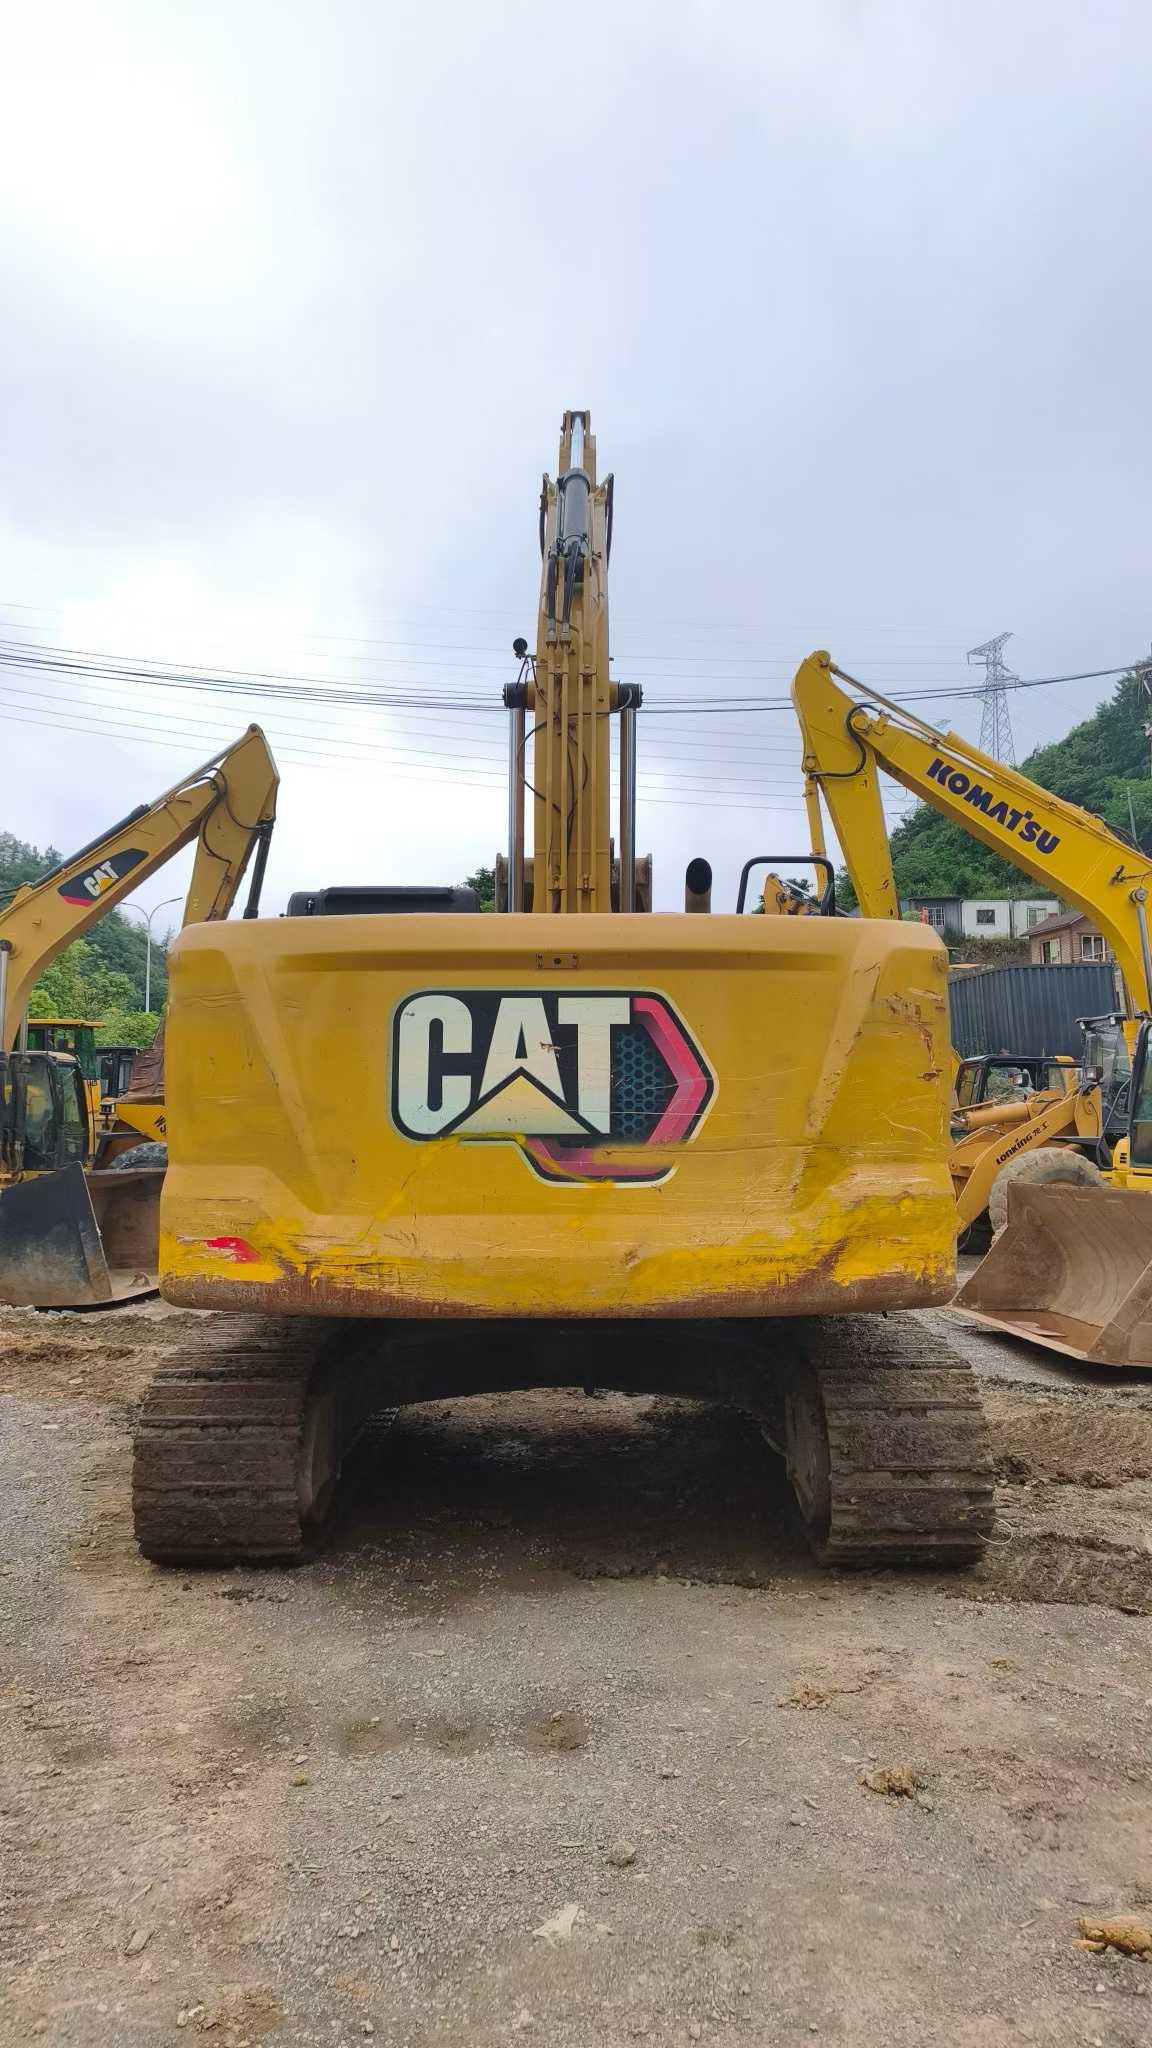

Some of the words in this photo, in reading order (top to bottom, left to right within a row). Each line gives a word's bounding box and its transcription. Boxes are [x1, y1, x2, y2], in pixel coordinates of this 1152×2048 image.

[927, 758, 1061, 855] KOMATSU
[84, 861, 120, 897] CAT
[398, 995, 631, 1134] CAT
